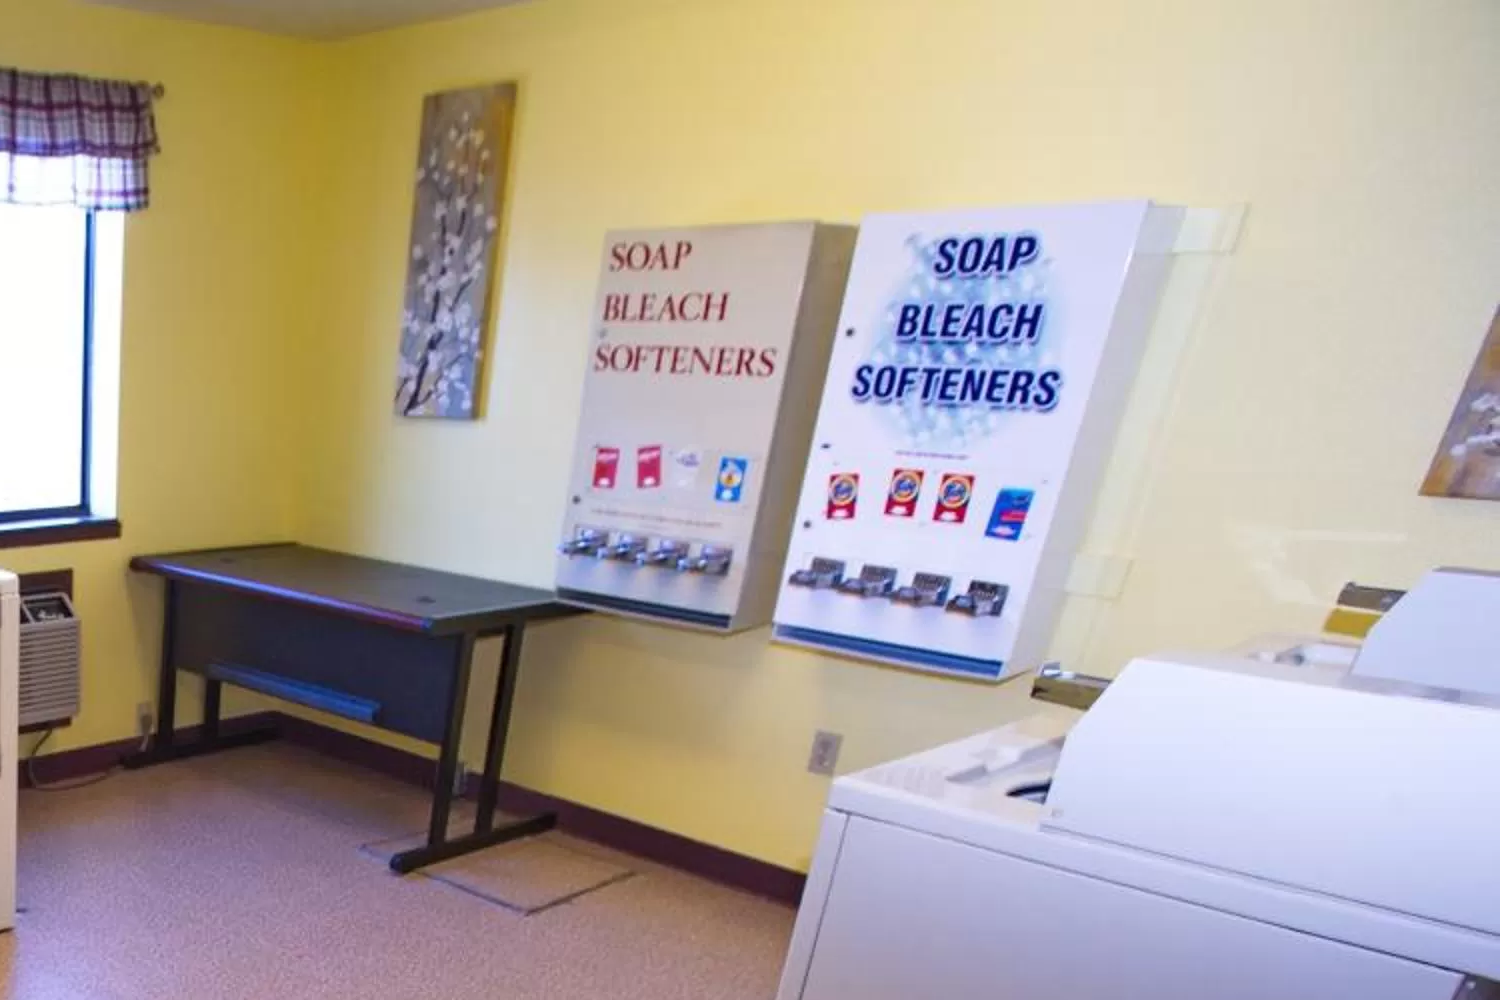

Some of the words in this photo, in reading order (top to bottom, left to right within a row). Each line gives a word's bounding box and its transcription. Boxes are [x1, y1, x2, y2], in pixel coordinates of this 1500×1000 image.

[609, 240, 693, 272] SOAP
[934, 236, 1039, 280] SOAP
[603, 292, 730, 322] BLEACH
[896, 303, 1044, 344] BLEACH
[593, 343, 777, 378] SOFTENERS
[851, 364, 1063, 412] SOFTENERS
